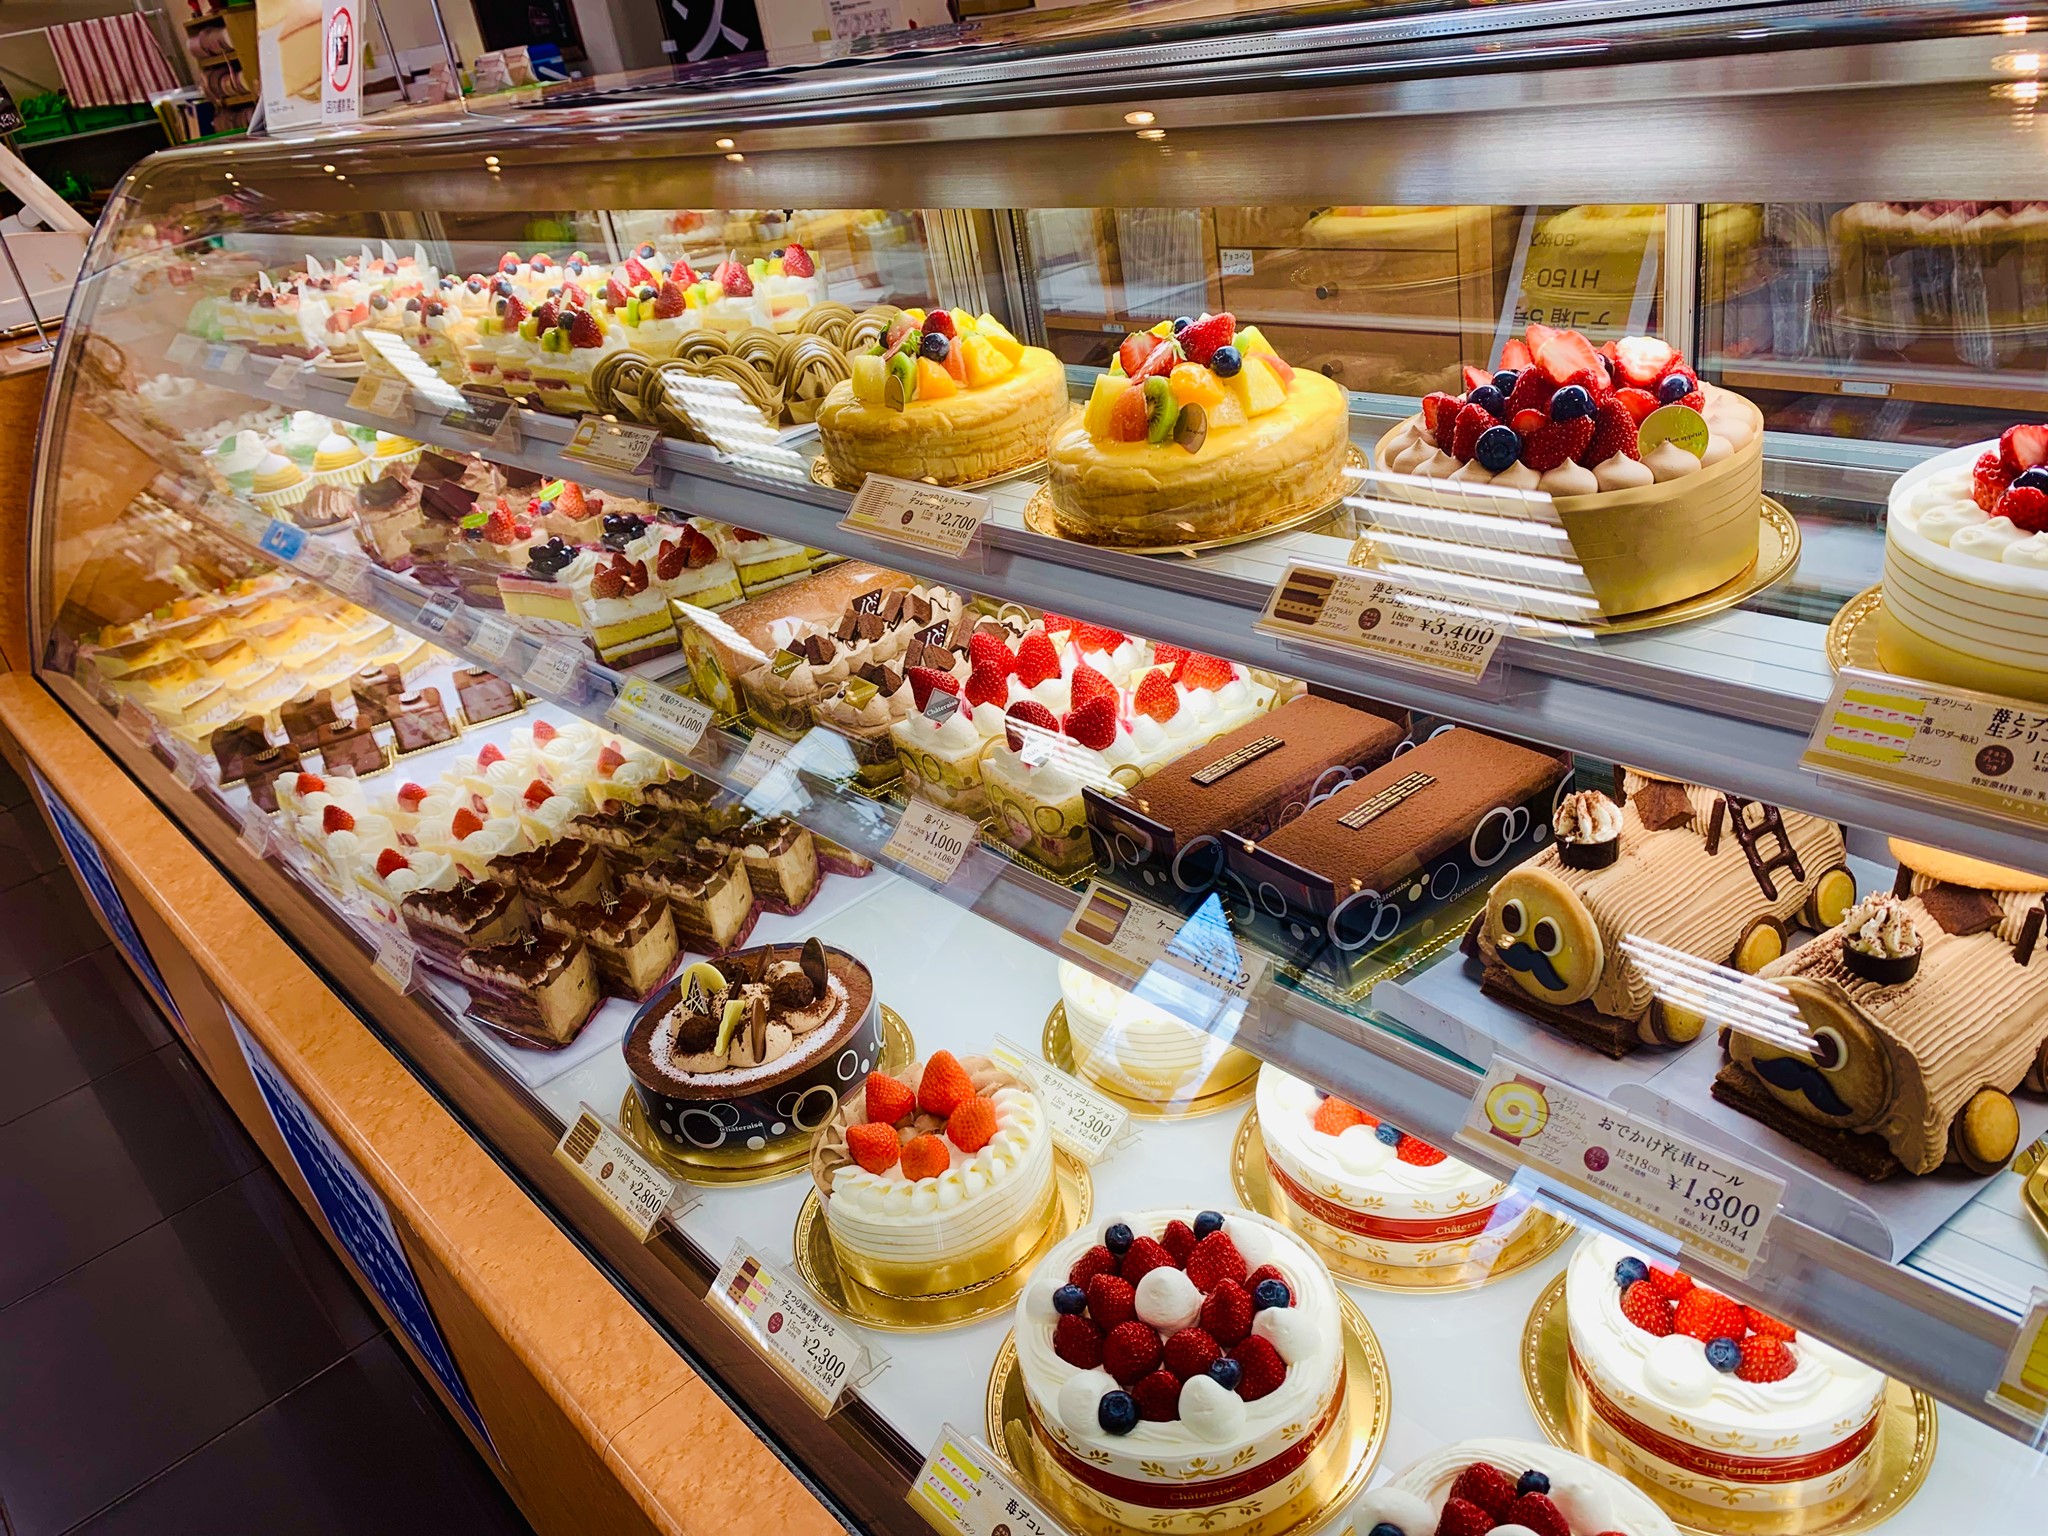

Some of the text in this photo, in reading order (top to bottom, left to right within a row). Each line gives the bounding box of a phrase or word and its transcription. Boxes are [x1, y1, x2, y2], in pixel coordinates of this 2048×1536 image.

[1537, 268, 1600, 289] H150
[933, 509, 976, 533] ¥2,700
[945, 527, 968, 539] ¥2,916
[1390, 610, 1496, 649] 18cm ¥3,400
[1442, 638, 1484, 656] ¥3,672
[1932, 697, 1972, 711] 生クリーム
[675, 714, 703, 733] ¥1,000
[1907, 754, 1942, 767] スポンジ
[921, 828, 963, 857] ¥1,000
[1041, 1072, 1117, 1125] 生クリームデコレーション
[1066, 1102, 1112, 1139] ¥2,300
[1077, 1126, 1102, 1146] ¥2,484
[1598, 1116, 1744, 1187] おでかけ汽車ロール
[626, 1177, 662, 1214] ¥2,800
[1667, 1174, 1760, 1228] ¥1,800
[634, 1202, 653, 1222] ¥3,024
[1700, 1212, 1749, 1241] ¥1,944
[778, 1298, 818, 1334] デコレーション
[784, 1289, 836, 1337] 2つの味が楽しめる
[786, 1318, 846, 1379] 15cm ¥2,300
[812, 1363, 837, 1388] ¥2,484
